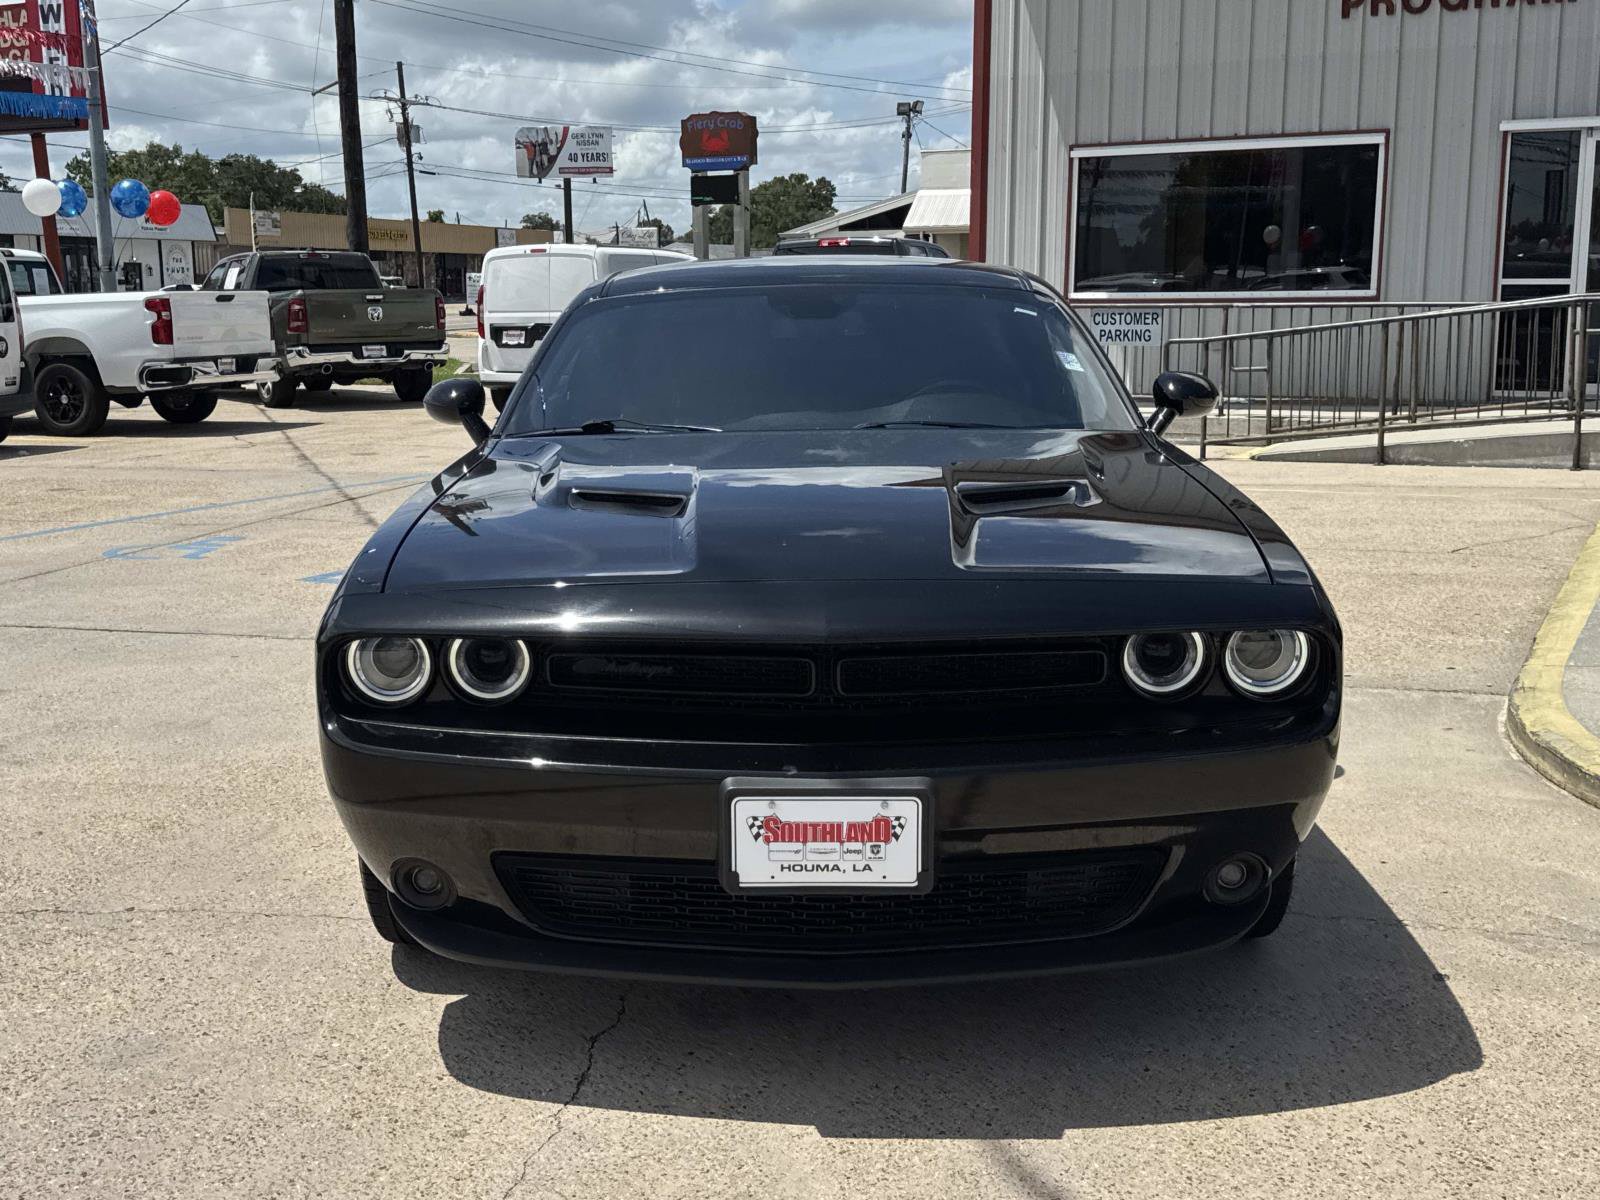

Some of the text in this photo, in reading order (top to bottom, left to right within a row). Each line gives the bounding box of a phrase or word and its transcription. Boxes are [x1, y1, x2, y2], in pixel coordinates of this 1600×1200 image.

[688, 117, 745, 133] Fiery Crab
[568, 152, 609, 162] 40 YEARS!
[1093, 312, 1159, 325] CUSTOMER
[1100, 329, 1152, 342] PARKING
[763, 815, 892, 845] SOUTHLAND
[780, 864, 873, 873] HOUMA, LA
